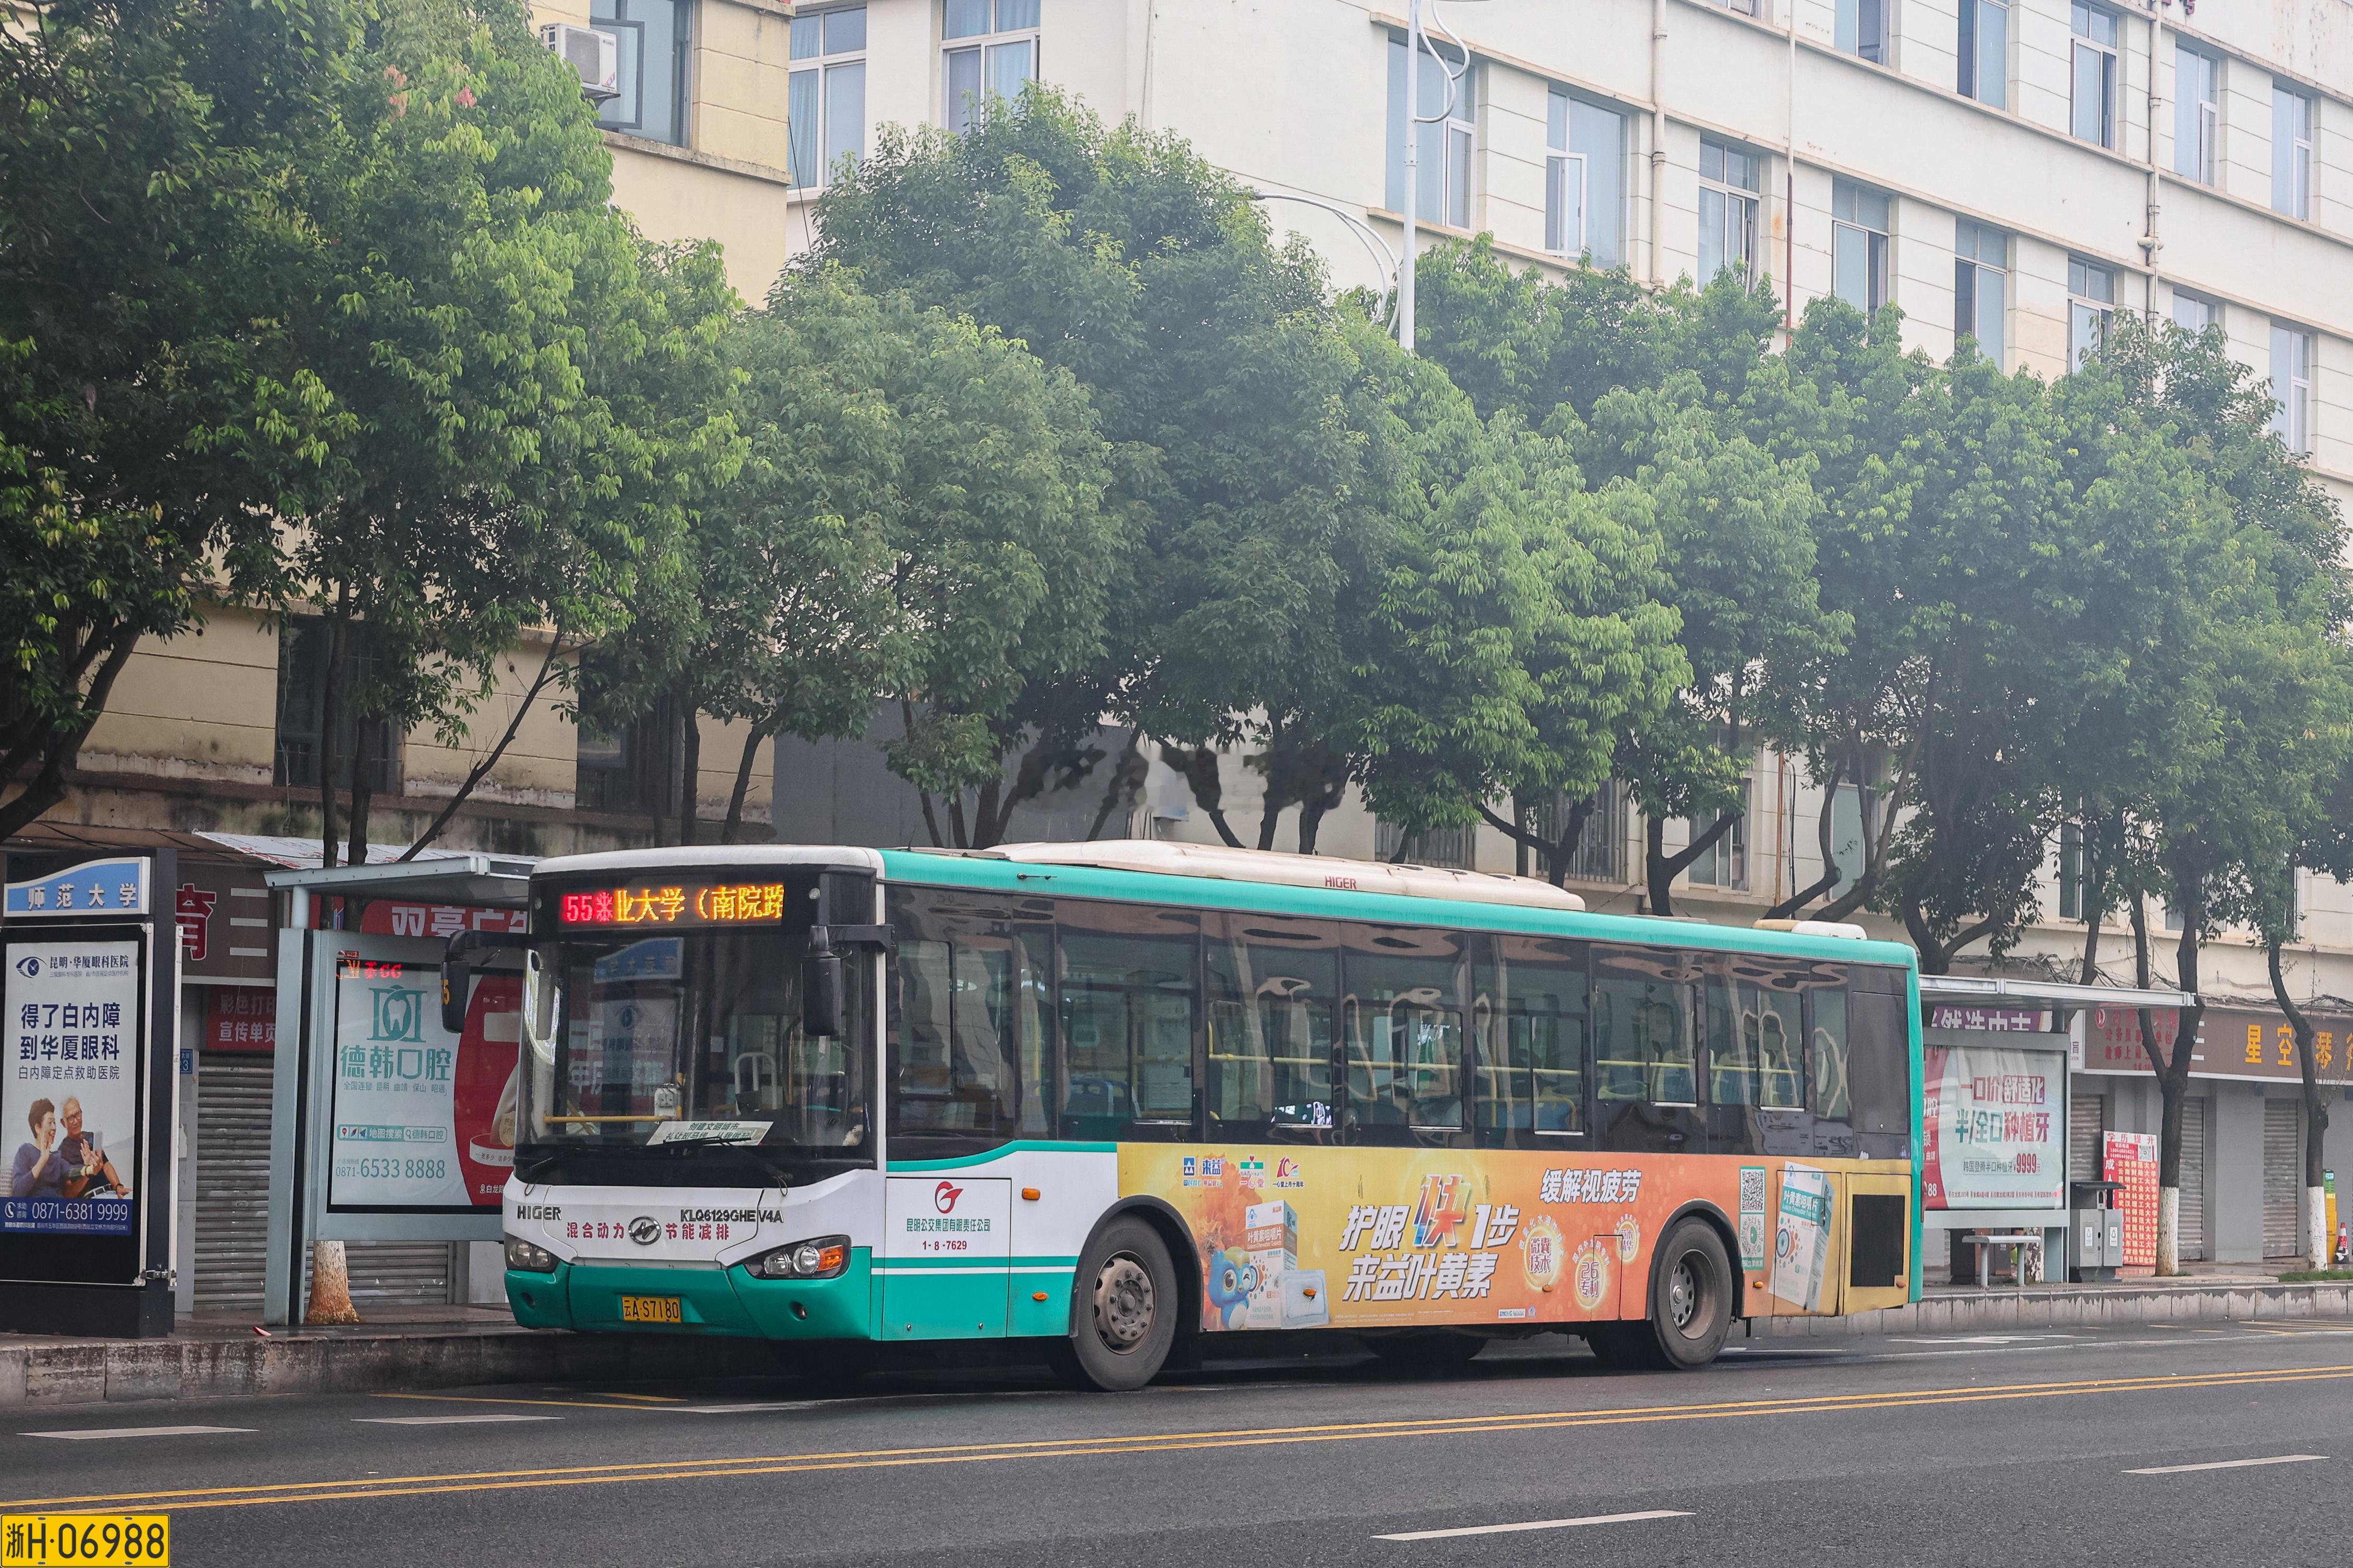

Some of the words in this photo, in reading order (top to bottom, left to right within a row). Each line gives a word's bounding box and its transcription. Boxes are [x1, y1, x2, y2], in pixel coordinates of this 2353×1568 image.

[1325, 875, 1357, 890] HIGER
[28, 883, 137, 910] 师范大学
[20, 1002, 120, 1029] 得了白内障
[20, 1034, 120, 1061] 到华厦眼科
[340, 1045, 452, 1081] 德韩口腔
[19, 1066, 120, 1080] 白内障定点救助医院
[369, 1128, 402, 1139] 地图搜索
[412, 1129, 444, 1140] 德韩口腔
[689, 1122, 740, 1131] 创建文明城市
[1955, 1108, 2050, 1144] 半/全口种植牙
[2107, 1132, 2154, 1144] 学历提升
[405, 1159, 445, 1179] 8888
[2117, 1160, 2156, 1169] 云南师范大学
[1240, 1178, 1264, 1188] 一心堂
[1539, 1168, 1643, 1205] 缓解视疲劳
[2118, 1176, 2157, 1185] 昆明理工大学
[2118, 1184, 2157, 1193] 南农业大学
[32, 1202, 93, 1220] 0871-6381
[97, 1204, 128, 1221] 9999
[517, 1205, 562, 1221] HIGER
[567, 1222, 625, 1239] 混合动力
[665, 1223, 730, 1240] 节能减排
[906, 1218, 990, 1232] 昆明公交集团有限责任公司
[1530, 1237, 1551, 1255] 微囊
[1530, 1255, 1551, 1274] 技术
[1582, 1262, 1599, 1280] 26
[1342, 1252, 1500, 1302] 来益叶黄素
[1580, 1280, 1599, 1297] 专利
